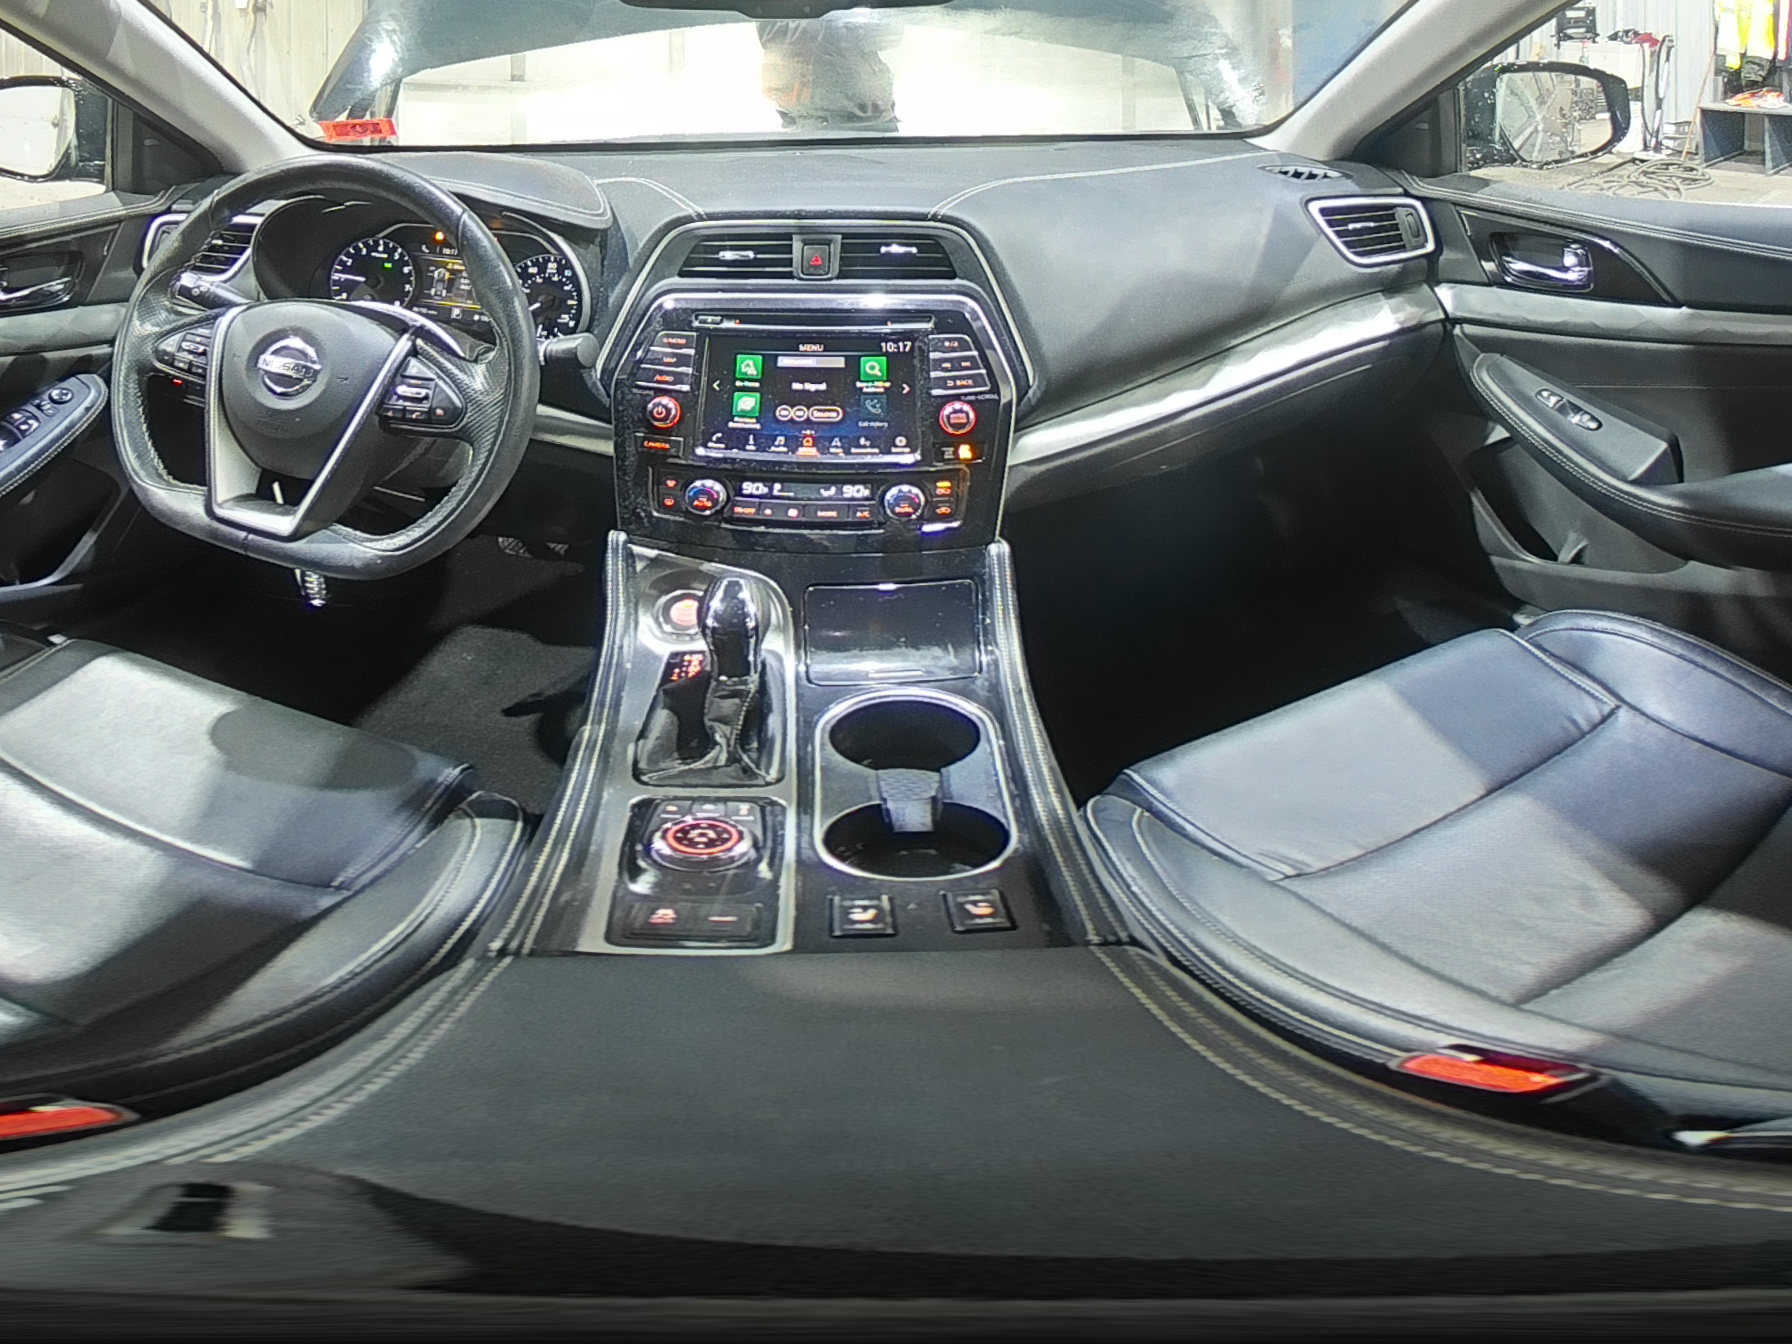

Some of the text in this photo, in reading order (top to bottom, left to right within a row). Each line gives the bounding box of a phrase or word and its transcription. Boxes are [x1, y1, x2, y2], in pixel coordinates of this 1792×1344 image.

[798, 343, 824, 352] MENU
[880, 341, 912, 353] 10:17
[260, 358, 315, 377] NISSAN
